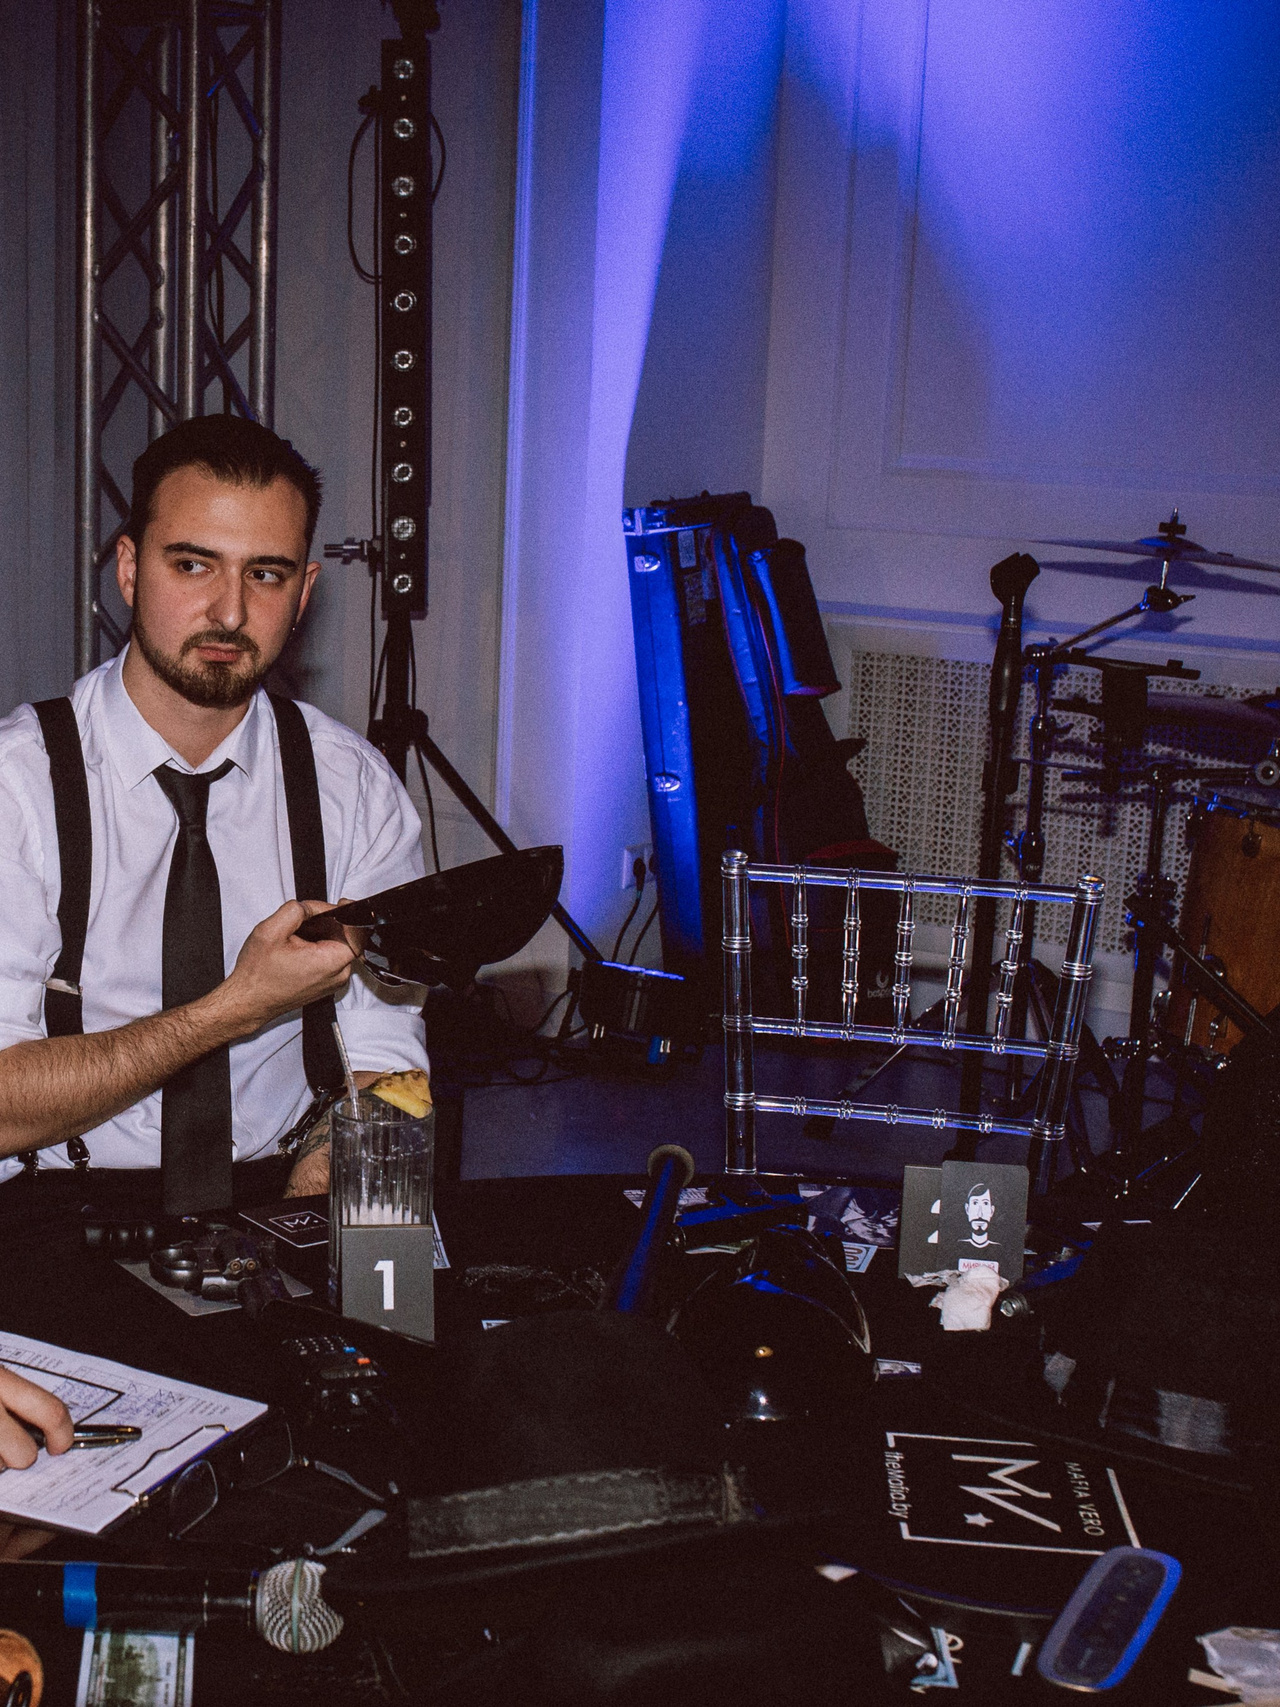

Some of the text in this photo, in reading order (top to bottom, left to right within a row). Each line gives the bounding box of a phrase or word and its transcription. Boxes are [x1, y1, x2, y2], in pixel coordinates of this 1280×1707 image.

[373, 1260, 395, 1310] 1
[1065, 1461, 1105, 1537] MAFIA VERO
